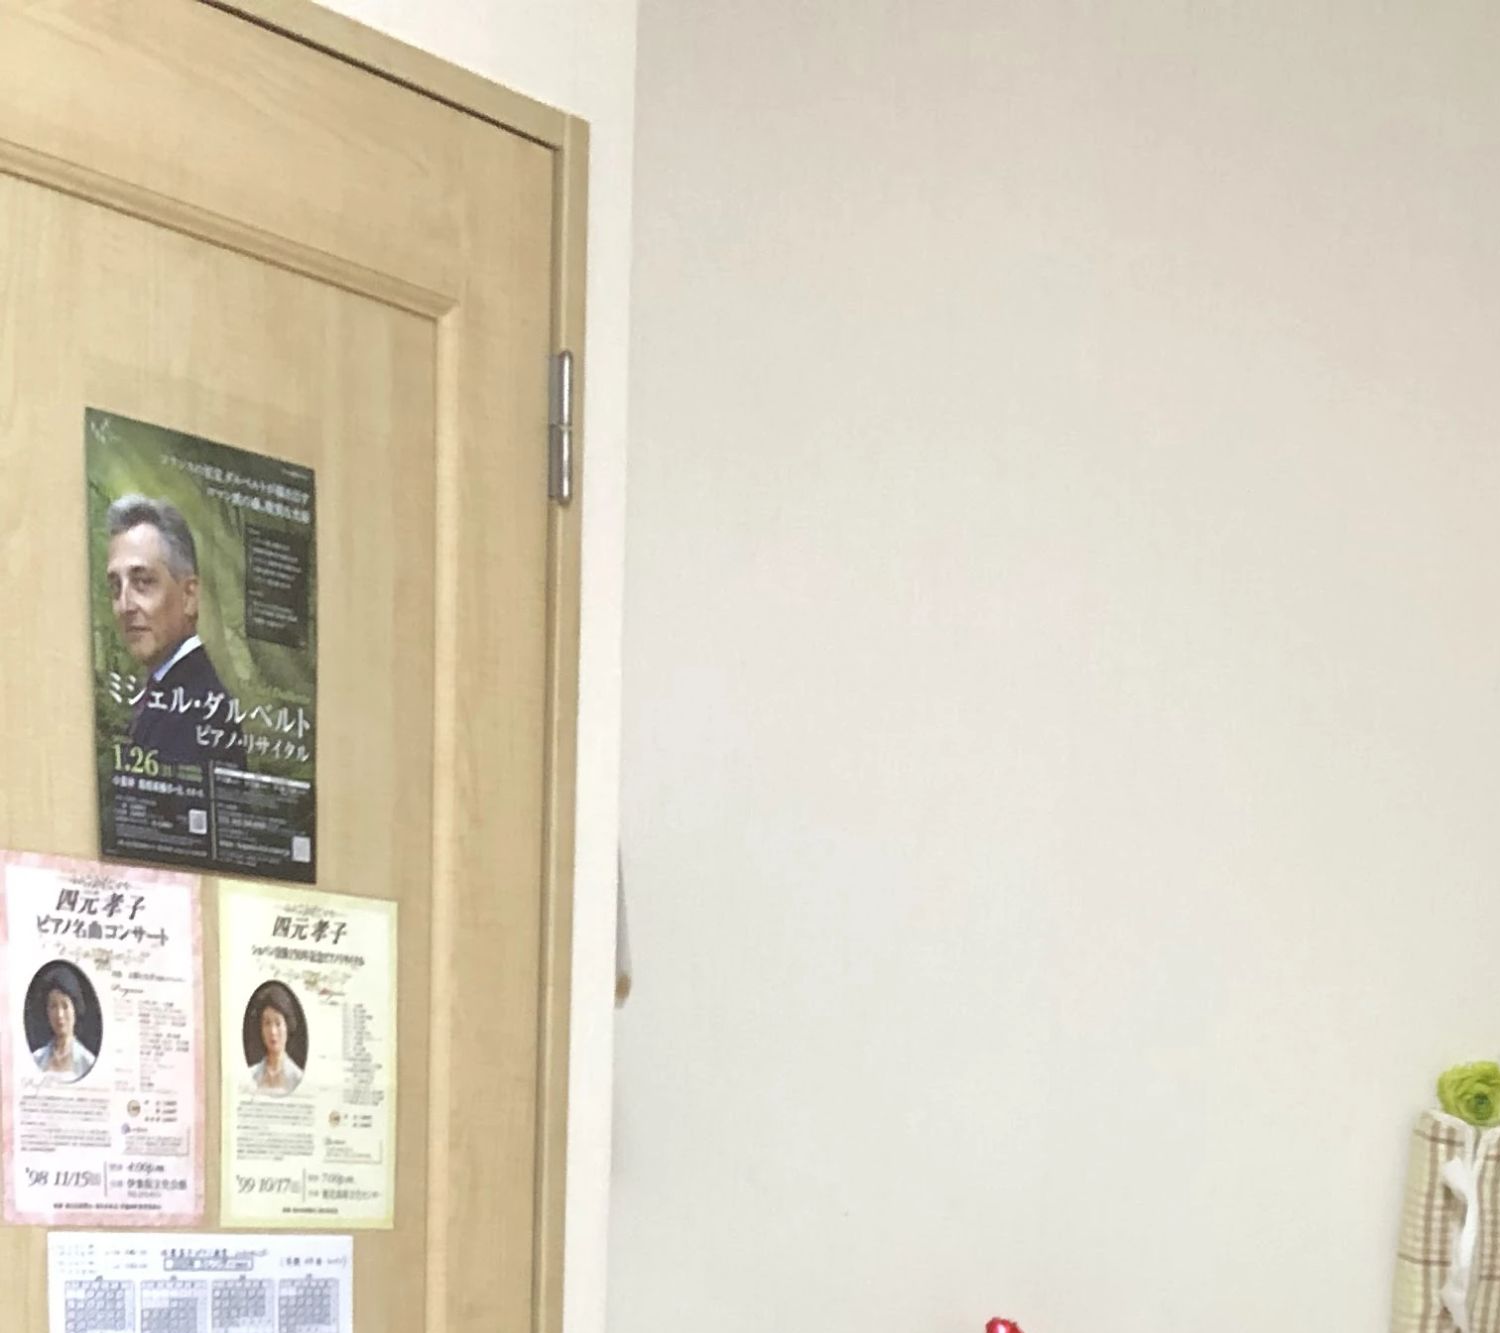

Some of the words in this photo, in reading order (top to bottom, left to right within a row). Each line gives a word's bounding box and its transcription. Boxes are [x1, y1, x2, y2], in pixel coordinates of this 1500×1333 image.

[109, 671, 311, 739] ミシェル・ダルベルト
[112, 743, 159, 776] 1.26
[37, 914, 169, 946] ピアノ名曲コンサート
